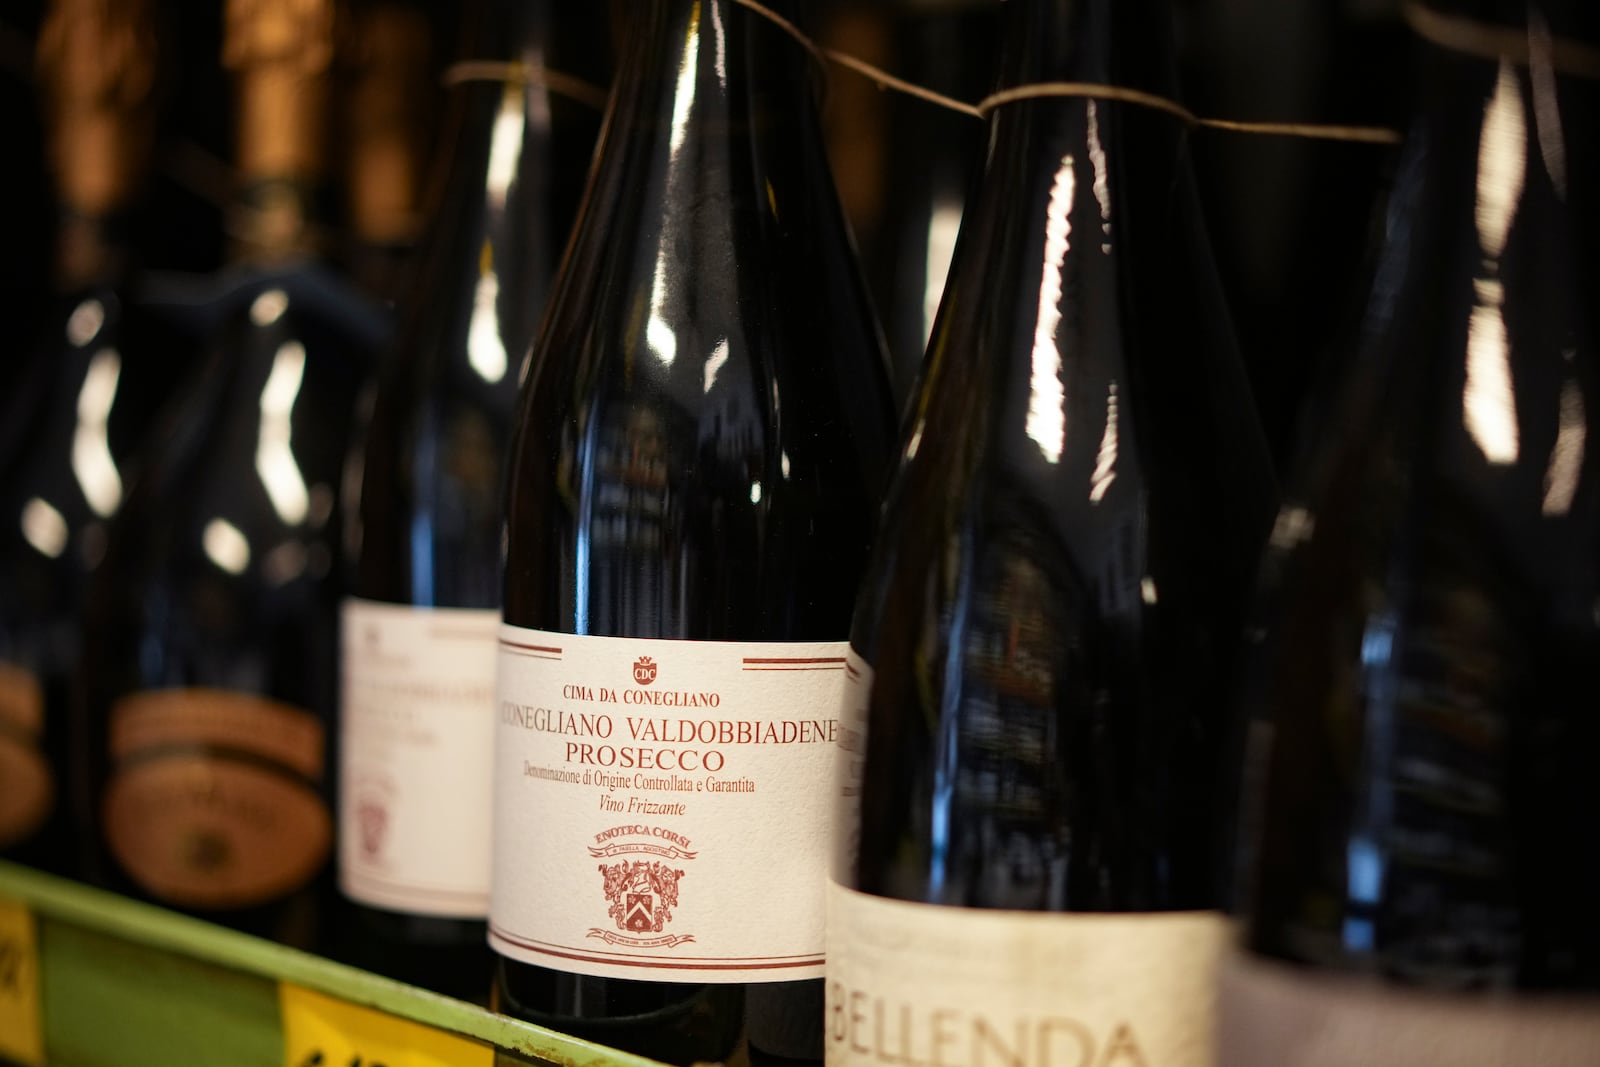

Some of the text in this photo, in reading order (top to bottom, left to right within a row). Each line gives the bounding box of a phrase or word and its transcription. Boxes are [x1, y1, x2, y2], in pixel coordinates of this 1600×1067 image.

[634, 668, 656, 681] CDC
[563, 684, 720, 708] CIMA DA CONEGLIANO
[626, 717, 838, 744] VALDOBBIADENE
[565, 742, 724, 772] PROSECCO
[524, 760, 755, 793] Denominazione di Origine Controllata e Garantita
[599, 794, 686, 816] Vino Frizzante
[594, 824, 692, 849] ENOTECA CORSI
[831, 983, 1150, 1067] BELLENDA
